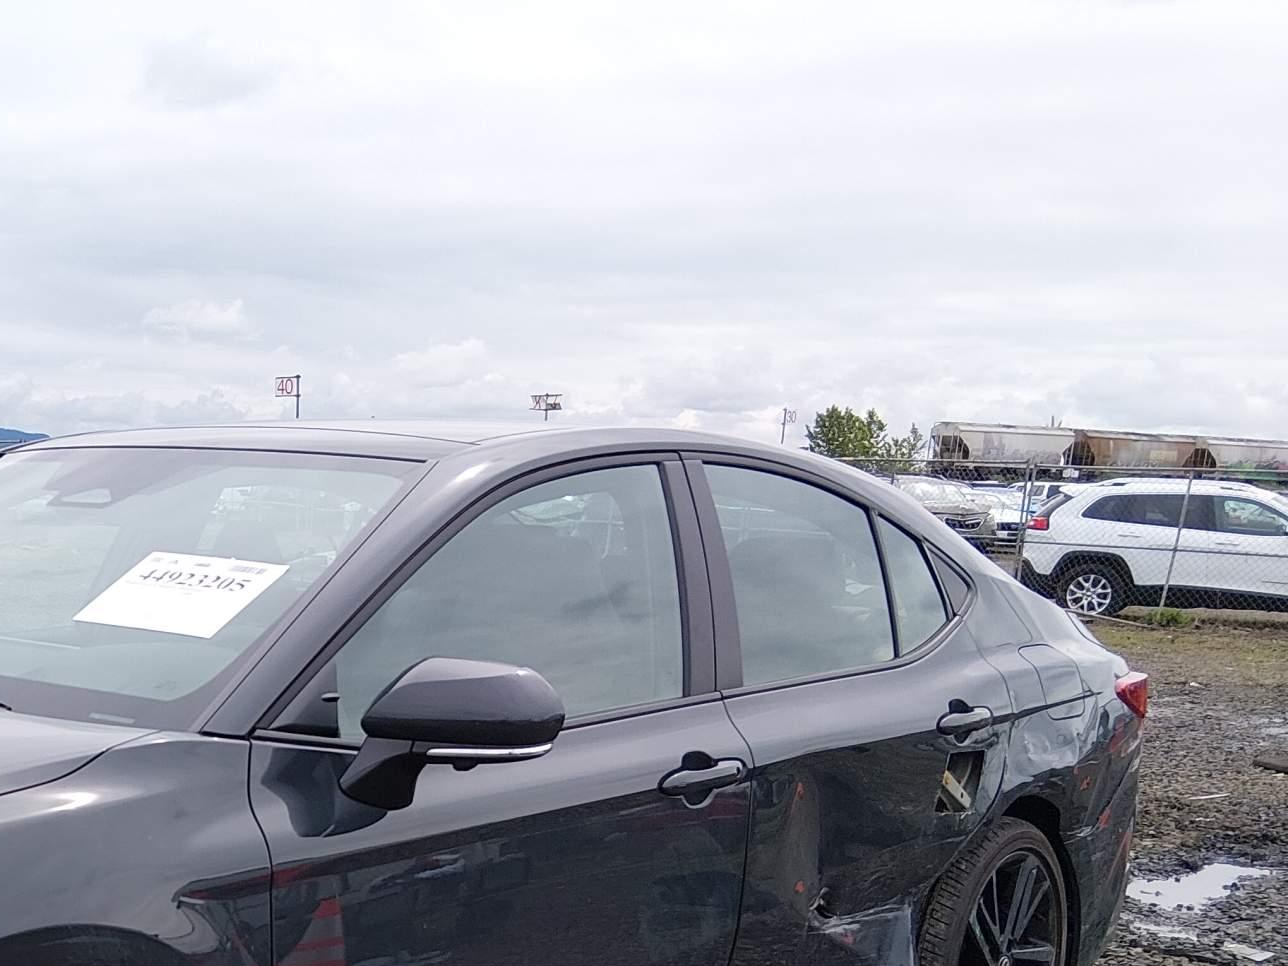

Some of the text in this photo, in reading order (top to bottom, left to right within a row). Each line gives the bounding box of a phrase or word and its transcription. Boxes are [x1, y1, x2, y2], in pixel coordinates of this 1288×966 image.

[277, 378, 294, 395] 40
[786, 410, 797, 423] 30
[139, 568, 253, 592] 44923205
